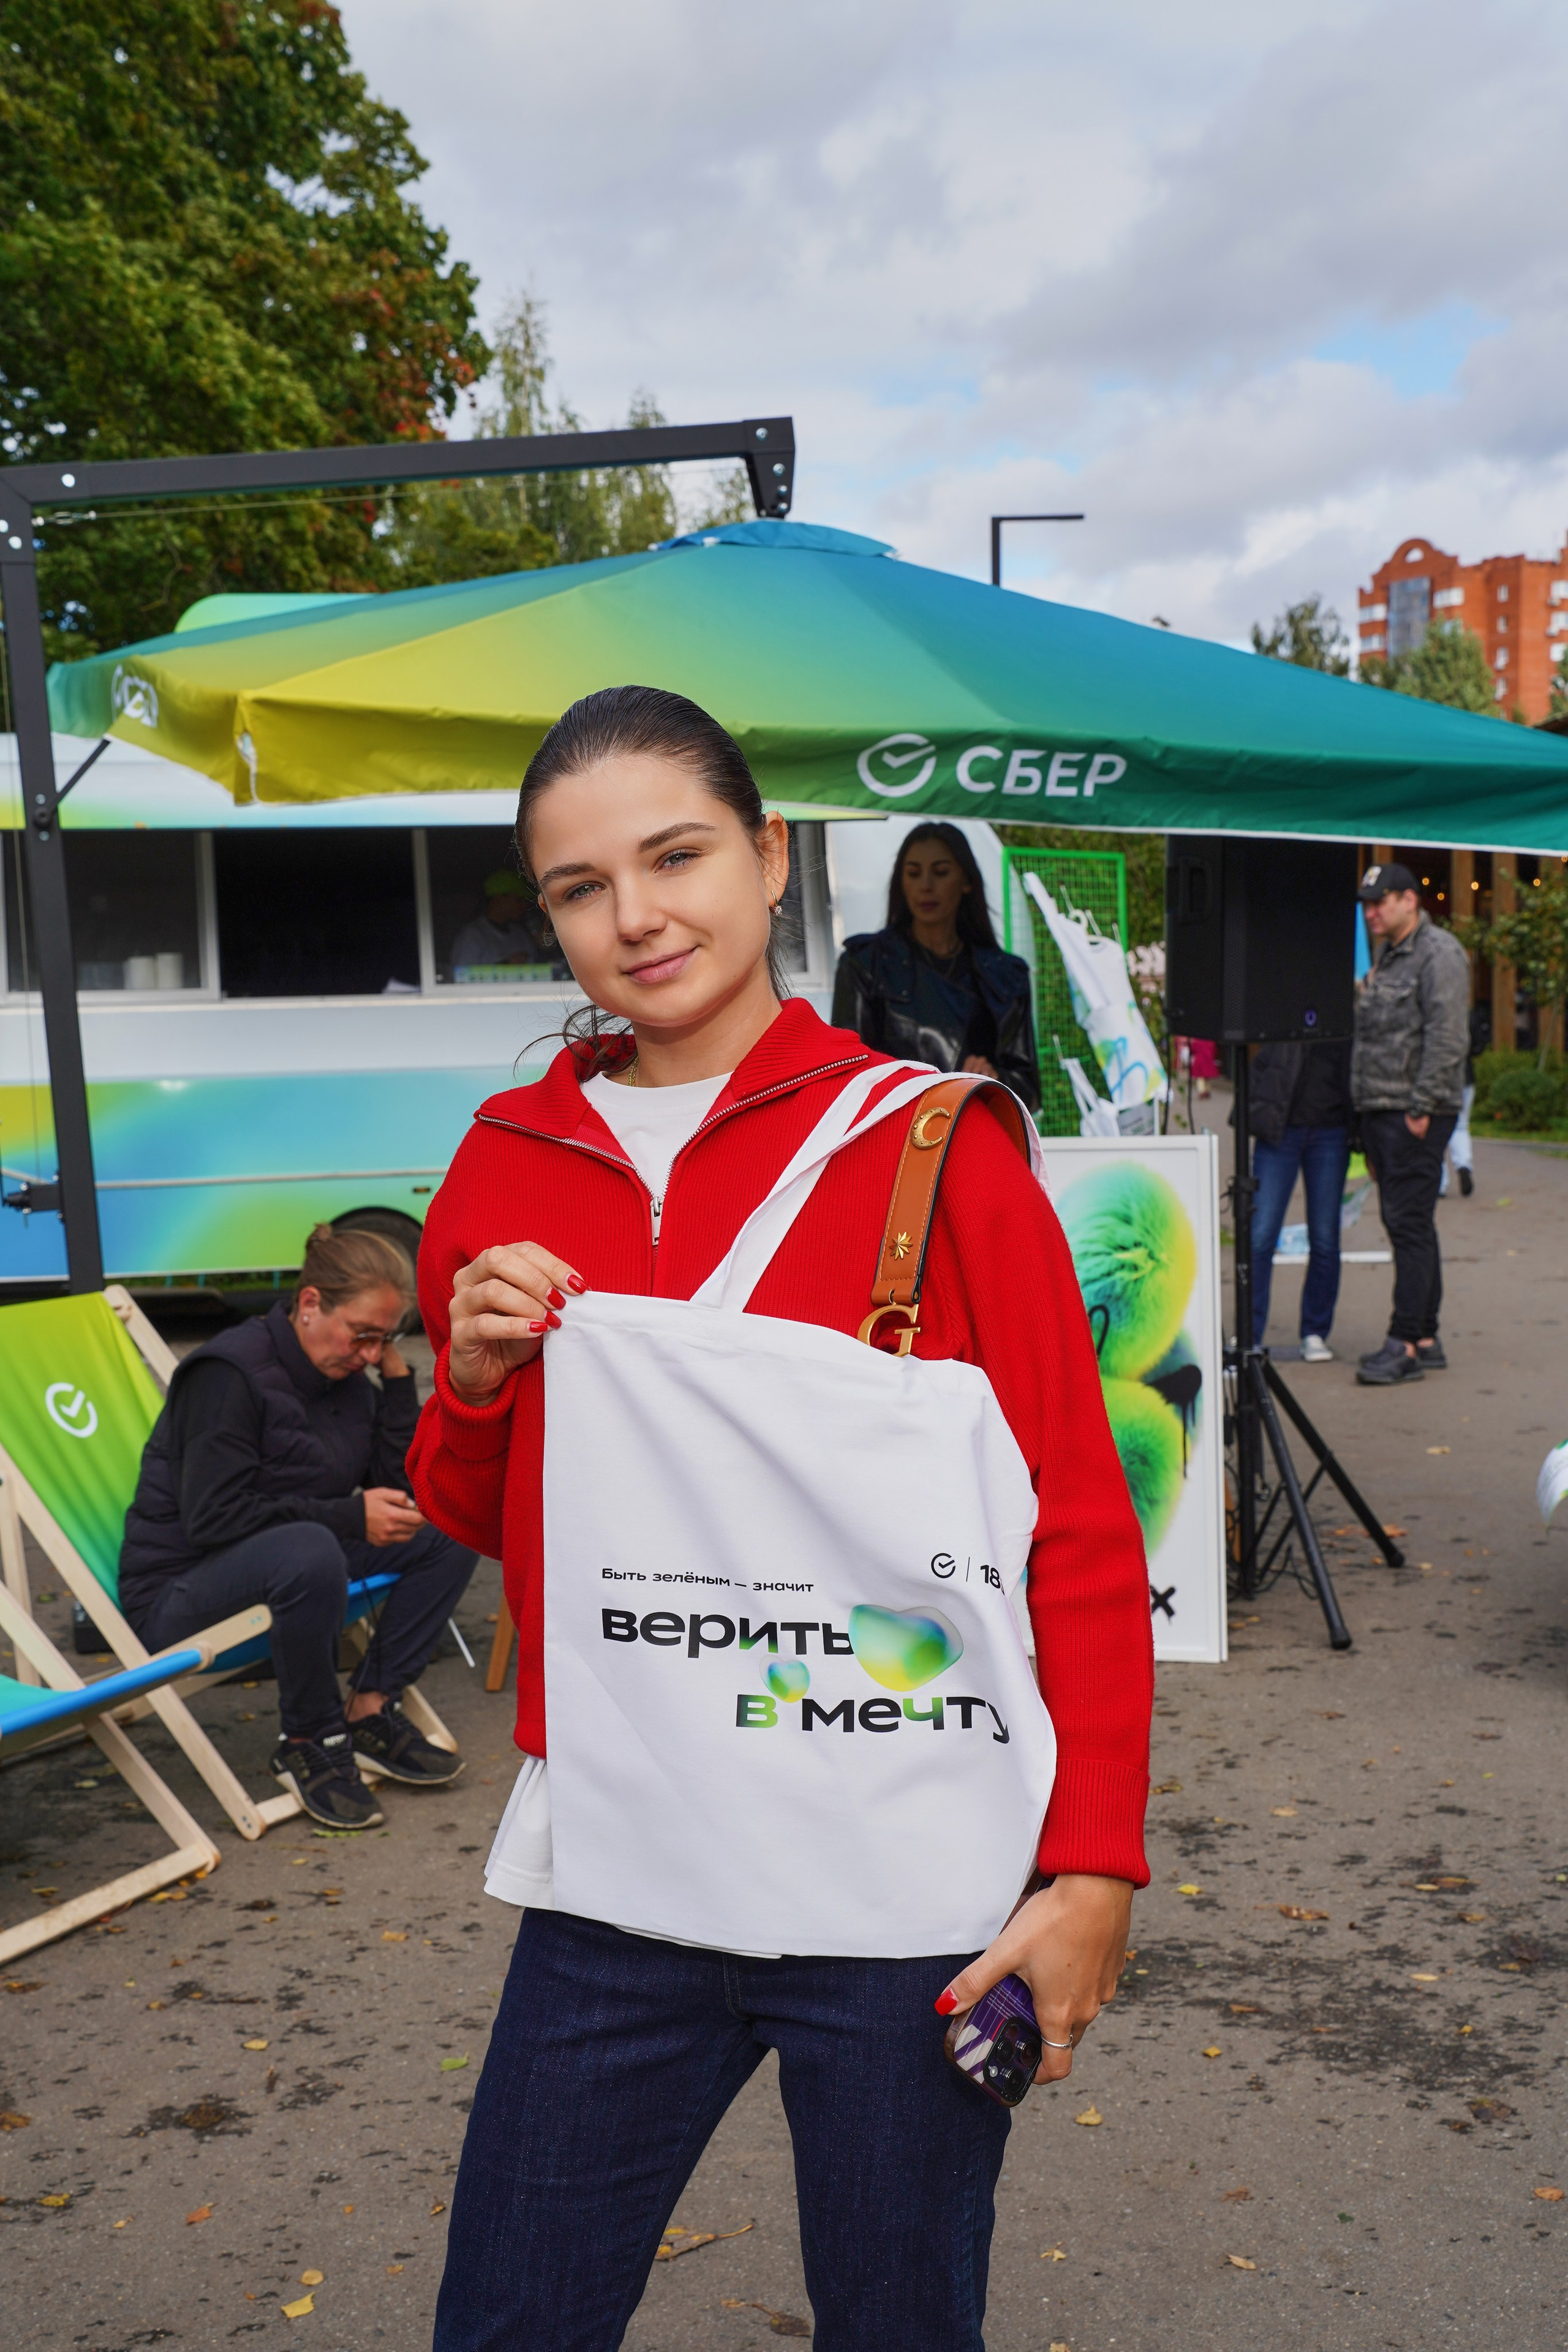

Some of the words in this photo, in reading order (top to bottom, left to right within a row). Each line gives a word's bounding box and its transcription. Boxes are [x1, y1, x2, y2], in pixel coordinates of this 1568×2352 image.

[956, 745, 1127, 797] СБЕР
[602, 1568, 647, 1581] Быть
[652, 1572, 730, 1586] зелёным
[753, 1582, 814, 1592] значит
[601, 1608, 854, 1658] верить
[802, 1696, 1010, 1744] мечту
